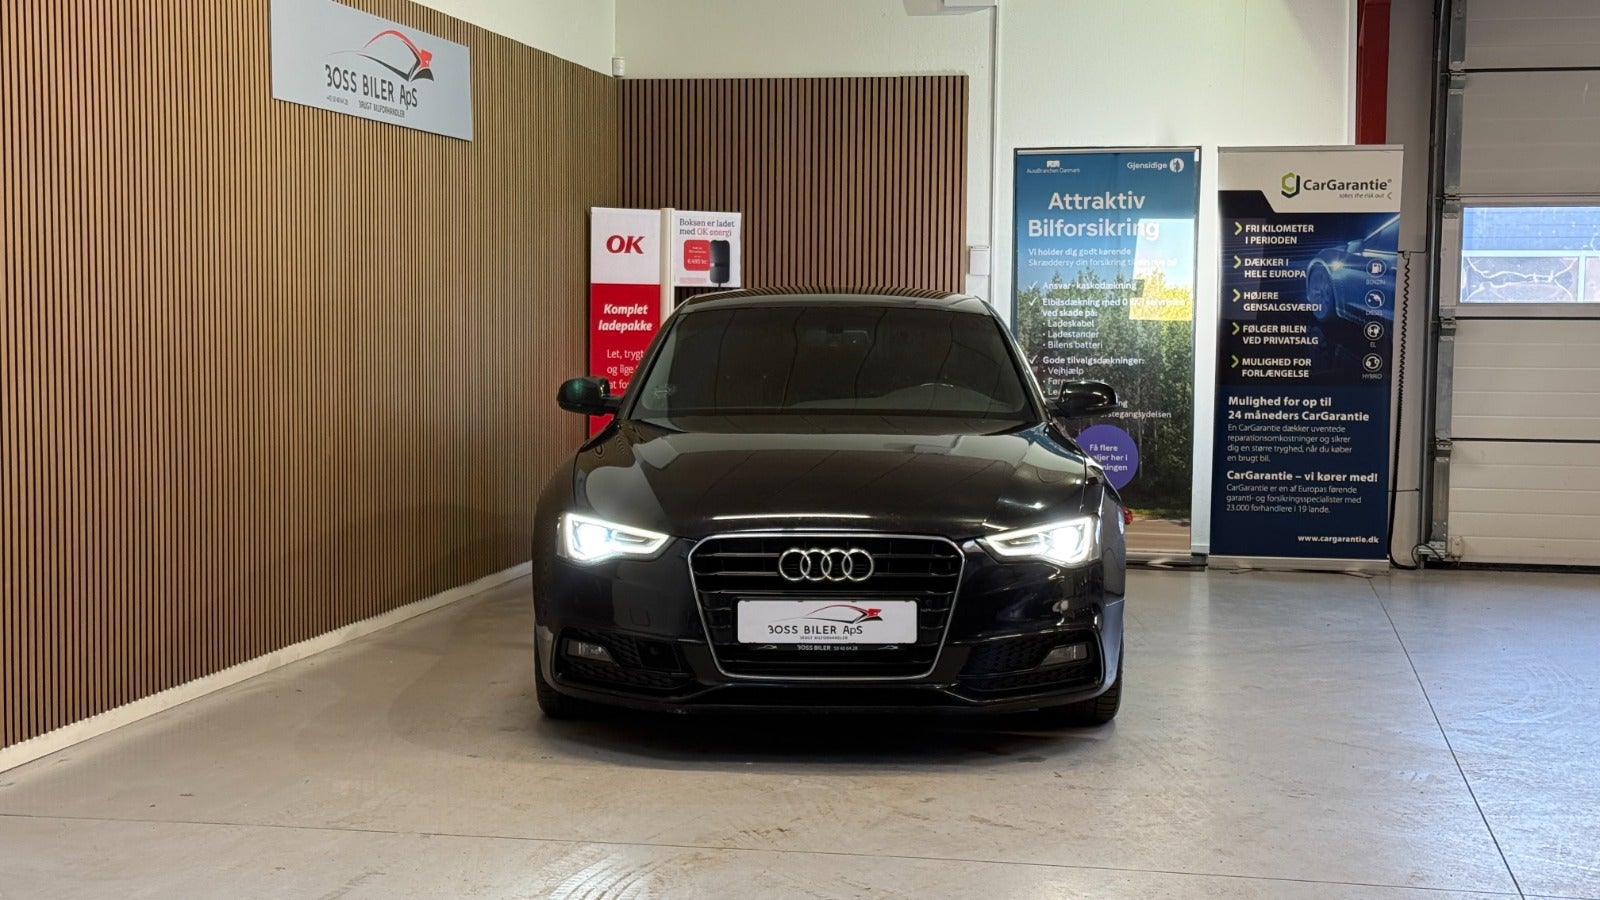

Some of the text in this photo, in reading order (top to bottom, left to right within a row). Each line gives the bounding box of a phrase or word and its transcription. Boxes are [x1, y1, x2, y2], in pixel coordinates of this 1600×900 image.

[362, 75, 395, 102] BILER
[400, 84, 418, 110] ApS
[1126, 162, 1168, 172] Gjensidige
[1048, 190, 1146, 210] Attraktiv
[679, 218, 706, 227] Boksen
[716, 220, 735, 228] ladet
[679, 227, 732, 238] med OK energi
[1028, 218, 1160, 240] Bilforsikring
[1245, 224, 1314, 233] FRI KILOMETER
[606, 234, 646, 254] OK
[1245, 236, 1297, 244] I PERIODEN
[1028, 248, 1036, 256] Vi
[1038, 248, 1064, 256] holder
[1064, 248, 1078, 258] dig
[1079, 248, 1098, 258] godt
[1028, 259, 1074, 268] Skræddersy
[1076, 259, 1088, 267] din
[1089, 259, 1126, 268] forsikring
[1244, 258, 1283, 267] DÆKKER
[1244, 270, 1306, 278] HELE EUROPA
[1243, 292, 1278, 300] HØJERE
[1102, 298, 1121, 306] med
[604, 304, 648, 317] Komplet
[1243, 303, 1322, 312] GENSALGSVÆRDI
[1042, 309, 1058, 317] ved
[1058, 309, 1083, 317] skade
[598, 320, 652, 333] ladepakke
[1047, 320, 1094, 328] Ladeskabel
[1242, 324, 1306, 334] FØLGER BILEN
[1047, 330, 1099, 338] Ladestander
[1047, 340, 1103, 349] Bilens batteri
[1242, 336, 1319, 345] VED PRIVATSALG
[606, 350, 644, 360] Let, trygt
[1042, 356, 1066, 364] Gode
[1242, 358, 1312, 366] MULIGHED FOR
[606, 366, 618, 376] og
[620, 364, 634, 377] lige
[1048, 366, 1084, 376] Vejhjælp
[1242, 369, 1310, 378] FORLÆNGELSE
[1228, 396, 1332, 408] Mulighed for op til
[1101, 410, 1172, 420] stegangsydelsen
[1228, 410, 1370, 422] 24 måneders CarGarantie
[1238, 424, 1281, 432] CarGarantie
[1282, 424, 1310, 432] dækker
[1310, 425, 1346, 433] uventede
[1227, 435, 1318, 444] reparationsomkostninger
[1330, 435, 1351, 443] sikrer
[1089, 444, 1099, 452] Få
[1227, 444, 1240, 453] dig
[1306, 444, 1318, 453] når
[1318, 445, 1330, 453] du
[1330, 446, 1352, 454] køber
[1238, 454, 1258, 463] brugt
[1226, 470, 1293, 480] CarGarantie
[1304, 472, 1314, 481] vi
[1316, 472, 1347, 482] kører
[1349, 472, 1378, 482] med!
[1298, 485, 1327, 494] Europas
[1328, 485, 1357, 493] førende
[1266, 494, 1343, 504] forsikringsspecialister
[1250, 504, 1292, 512] forhandlere
[1298, 536, 1379, 544] www.cargarantie.dk
[804, 625, 836, 634] BILER
[842, 625, 863, 636] ApS
